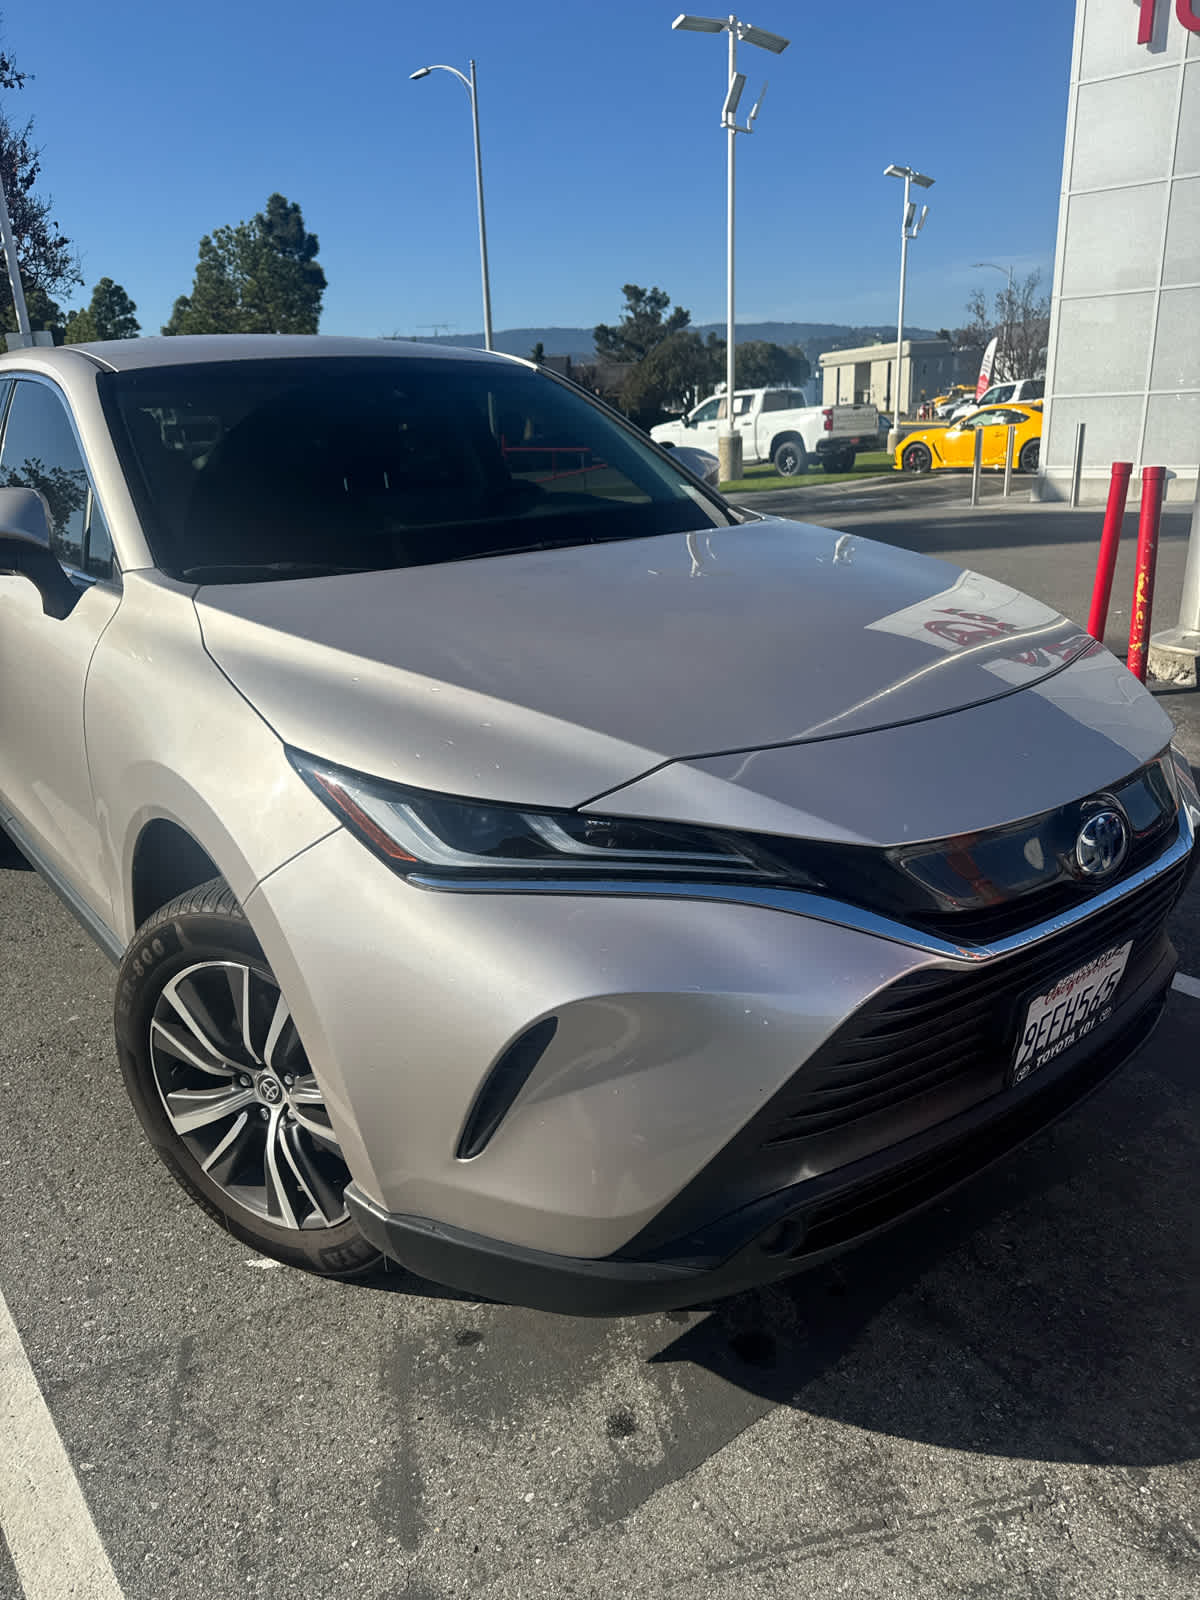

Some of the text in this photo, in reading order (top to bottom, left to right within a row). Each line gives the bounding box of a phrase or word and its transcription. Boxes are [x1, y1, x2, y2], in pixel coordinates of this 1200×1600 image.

[1020, 967, 1121, 1063] 9EFH565
[1036, 1017, 1096, 1068] TOYOTA 101
